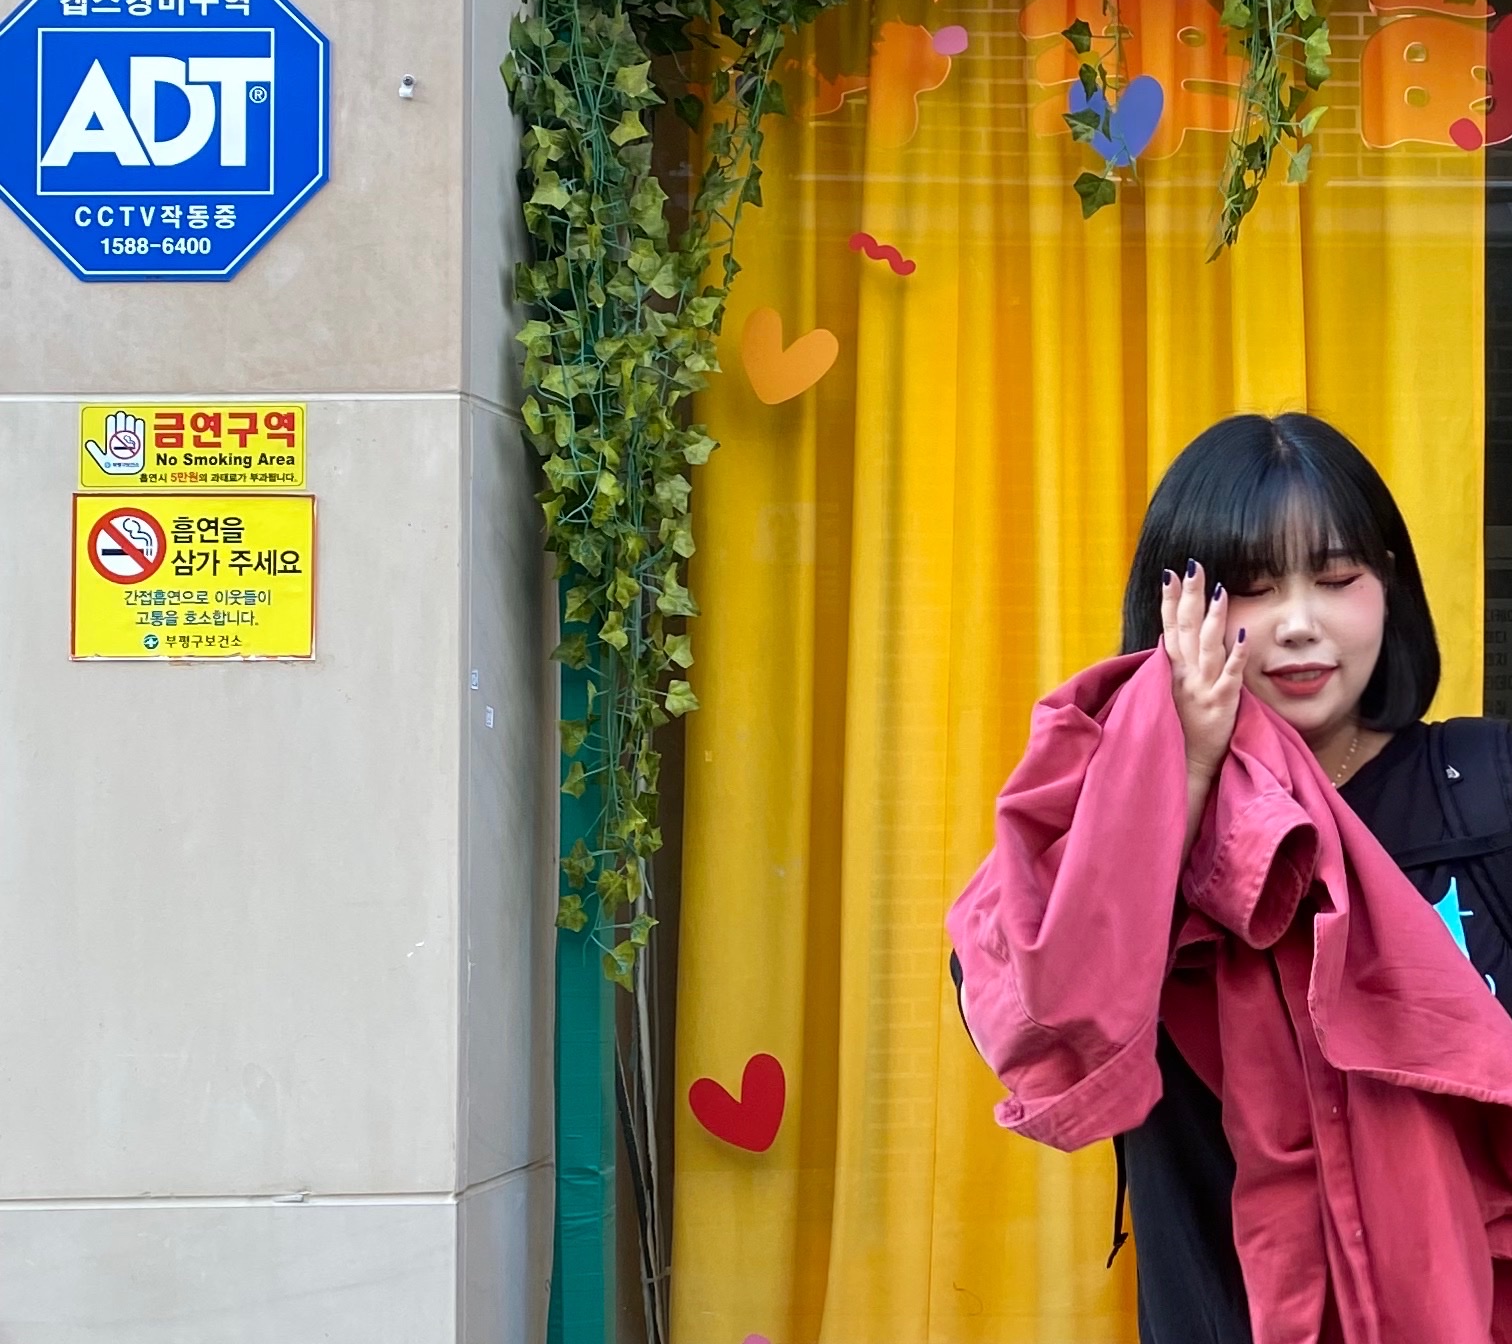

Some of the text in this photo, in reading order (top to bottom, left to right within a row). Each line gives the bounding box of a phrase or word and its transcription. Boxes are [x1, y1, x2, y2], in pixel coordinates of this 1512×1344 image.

[74, 204, 237, 229] CCTV작동중
[100, 237, 212, 255] 1588-6400
[153, 412, 296, 449] 금연구역
[156, 452, 295, 469] No Smoking Area
[139, 471, 299, 483] 흡연시 5만원의 과태료가 부과됩니다.
[170, 516, 245, 544] 흡연을
[170, 549, 303, 576] 삼가 주세요
[124, 590, 272, 606] 간접흡연으로 이웃들이
[135, 610, 259, 626] 고통을 호소합니다.
[165, 635, 243, 648] 부평구보건소
